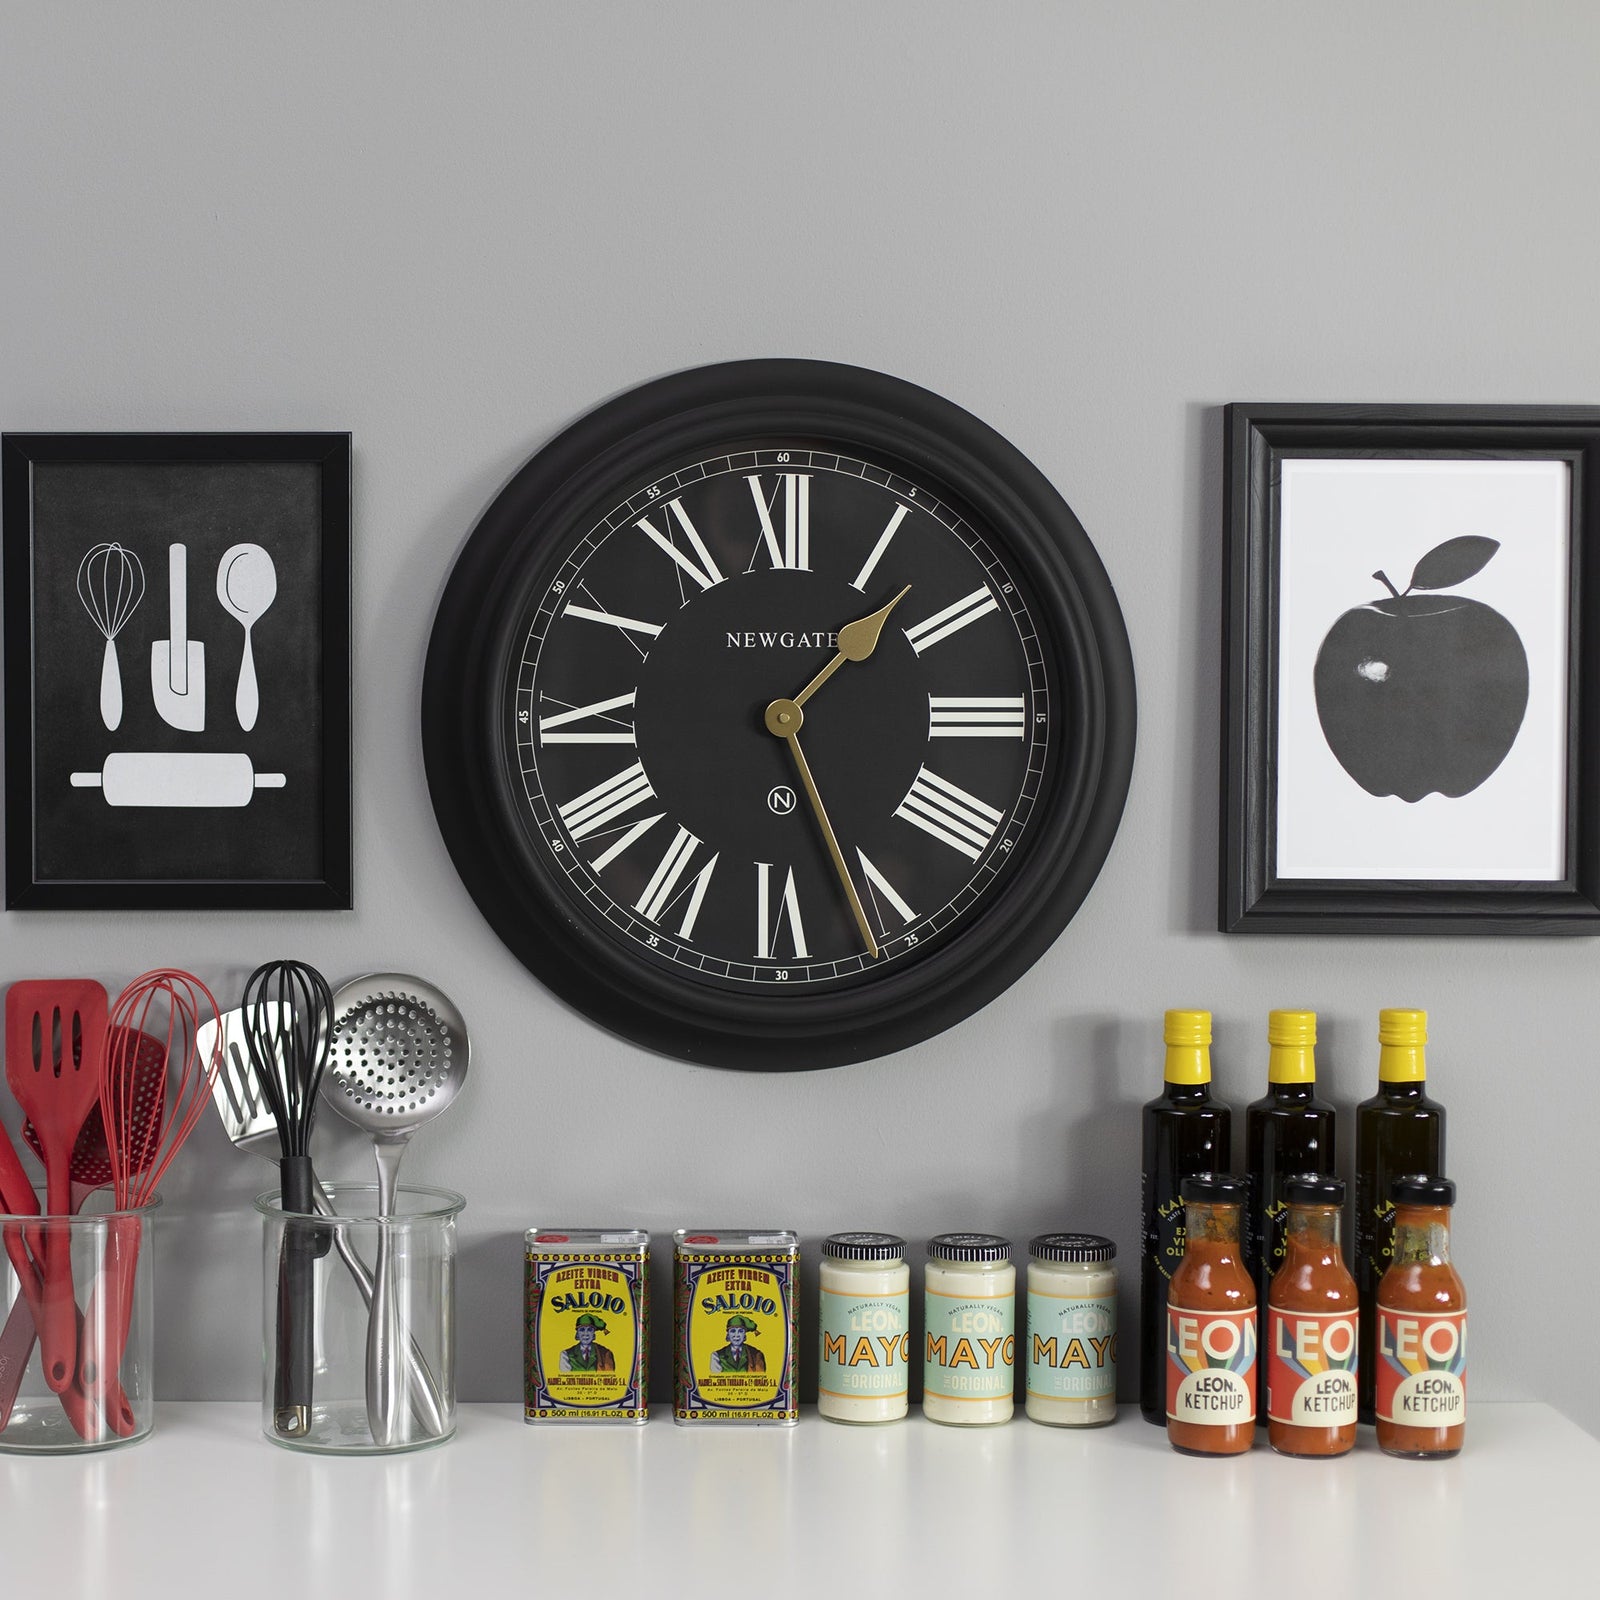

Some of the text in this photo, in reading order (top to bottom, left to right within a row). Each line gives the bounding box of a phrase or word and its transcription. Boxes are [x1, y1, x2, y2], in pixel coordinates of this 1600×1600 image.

[776, 452, 790, 463] 60
[646, 485, 661, 499] 55
[908, 487, 918, 497] 5
[742, 473, 814, 574] XII
[632, 495, 729, 609] XI
[848, 501, 913, 594] I
[552, 580, 566, 594] 50
[1001, 582, 1013, 594] 10
[560, 578, 667, 663] X
[901, 581, 1001, 658] II
[725, 631, 839, 648] NEWGATE
[518, 710, 529, 724] 45
[539, 686, 637, 748] IX
[928, 692, 1024, 741] III
[1035, 712, 1046, 723] 15
[556, 757, 667, 877] VIII
[891, 762, 1006, 864] IIII
[551, 838, 564, 852] 40
[1000, 838, 1014, 853] 20
[630, 823, 720, 942] VII
[855, 845, 921, 938] V
[753, 862, 813, 959] VI
[645, 934, 660, 948] 35
[903, 933, 919, 947] 25
[775, 970, 788, 981] 30
[556, 1268, 584, 1283] AZEITE
[707, 1270, 735, 1284] AZEITE
[574, 1279, 601, 1290] EXTRA
[725, 1280, 752, 1291] EXTRA
[551, 1291, 625, 1314] SALOIO
[702, 1293, 776, 1315] SALOIO
[848, 1302, 902, 1315] NATURALLY VEGAN
[948, 1304, 1004, 1316] NATURALLY VEGAN
[1058, 1303, 1111, 1317] NATURALLY VEGAN
[850, 1310, 903, 1332] LEON.
[951, 1311, 1004, 1334] LEON.
[1061, 1311, 1111, 1334] LEON.
[1276, 1317, 1359, 1361] LEO
[926, 1331, 1015, 1369] MAYO
[851, 1372, 903, 1389] ORIGINAL
[951, 1374, 1006, 1391] ORIGINAL
[1063, 1373, 1113, 1391] ORIGINAL
[1196, 1377, 1237, 1392] LEON.
[1316, 1378, 1352, 1394] LEON.
[1416, 1379, 1455, 1394] LEON.
[1184, 1393, 1244, 1410] KETCHUP
[1304, 1393, 1356, 1412] KETCHUP
[1403, 1395, 1461, 1412] KETCHUP
[568, 1409, 579, 1417] ml
[719, 1410, 730, 1418] ml
